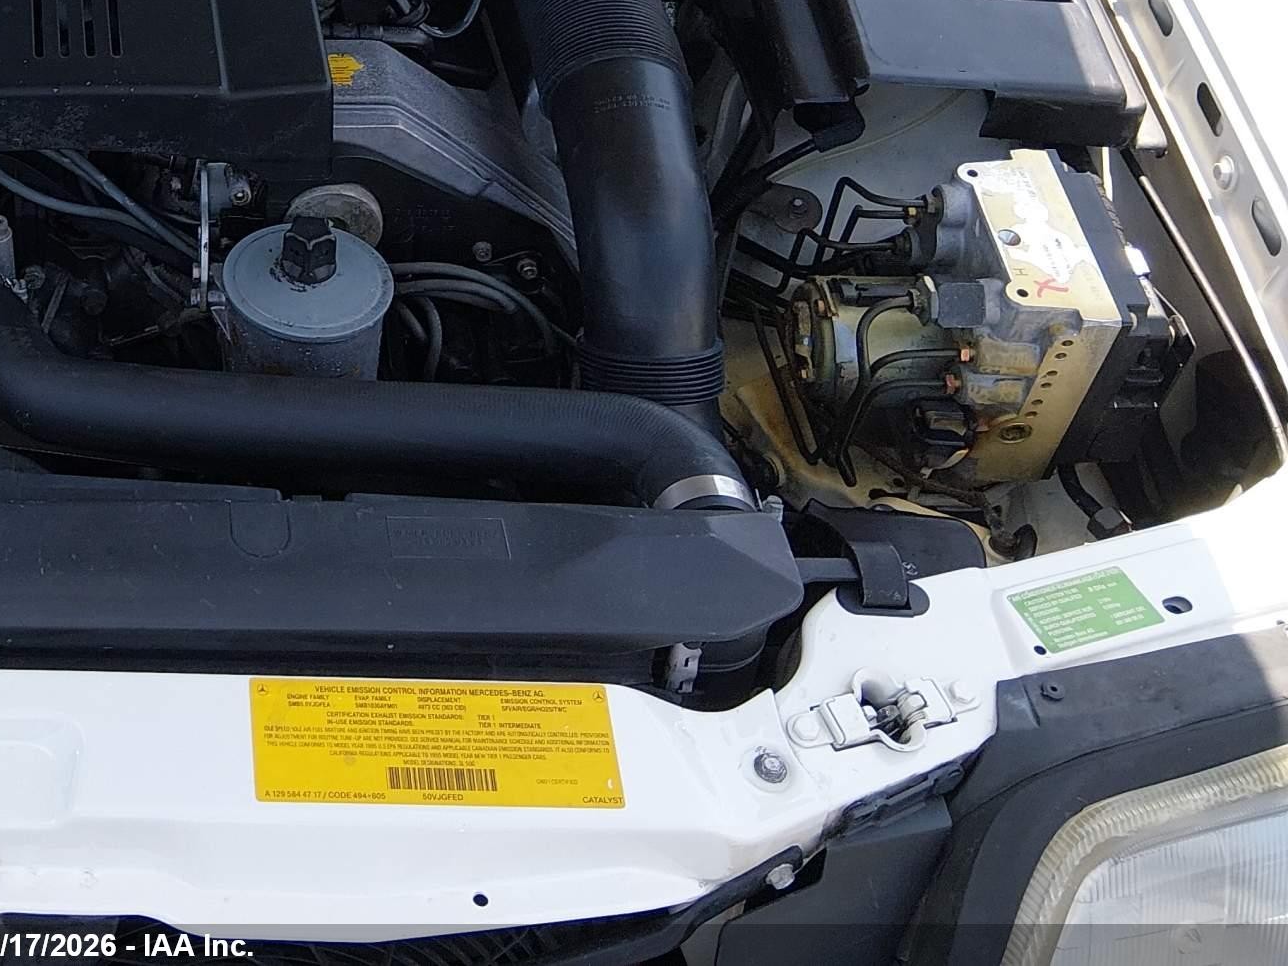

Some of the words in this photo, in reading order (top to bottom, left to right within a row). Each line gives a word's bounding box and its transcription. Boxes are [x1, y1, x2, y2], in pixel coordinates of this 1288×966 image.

[347, 686, 380, 694] EMISSION
[418, 688, 468, 696] INFORMATION
[468, 689, 532, 697] MERCEDES-BENZ
[582, 796, 624, 804] CATALYST
